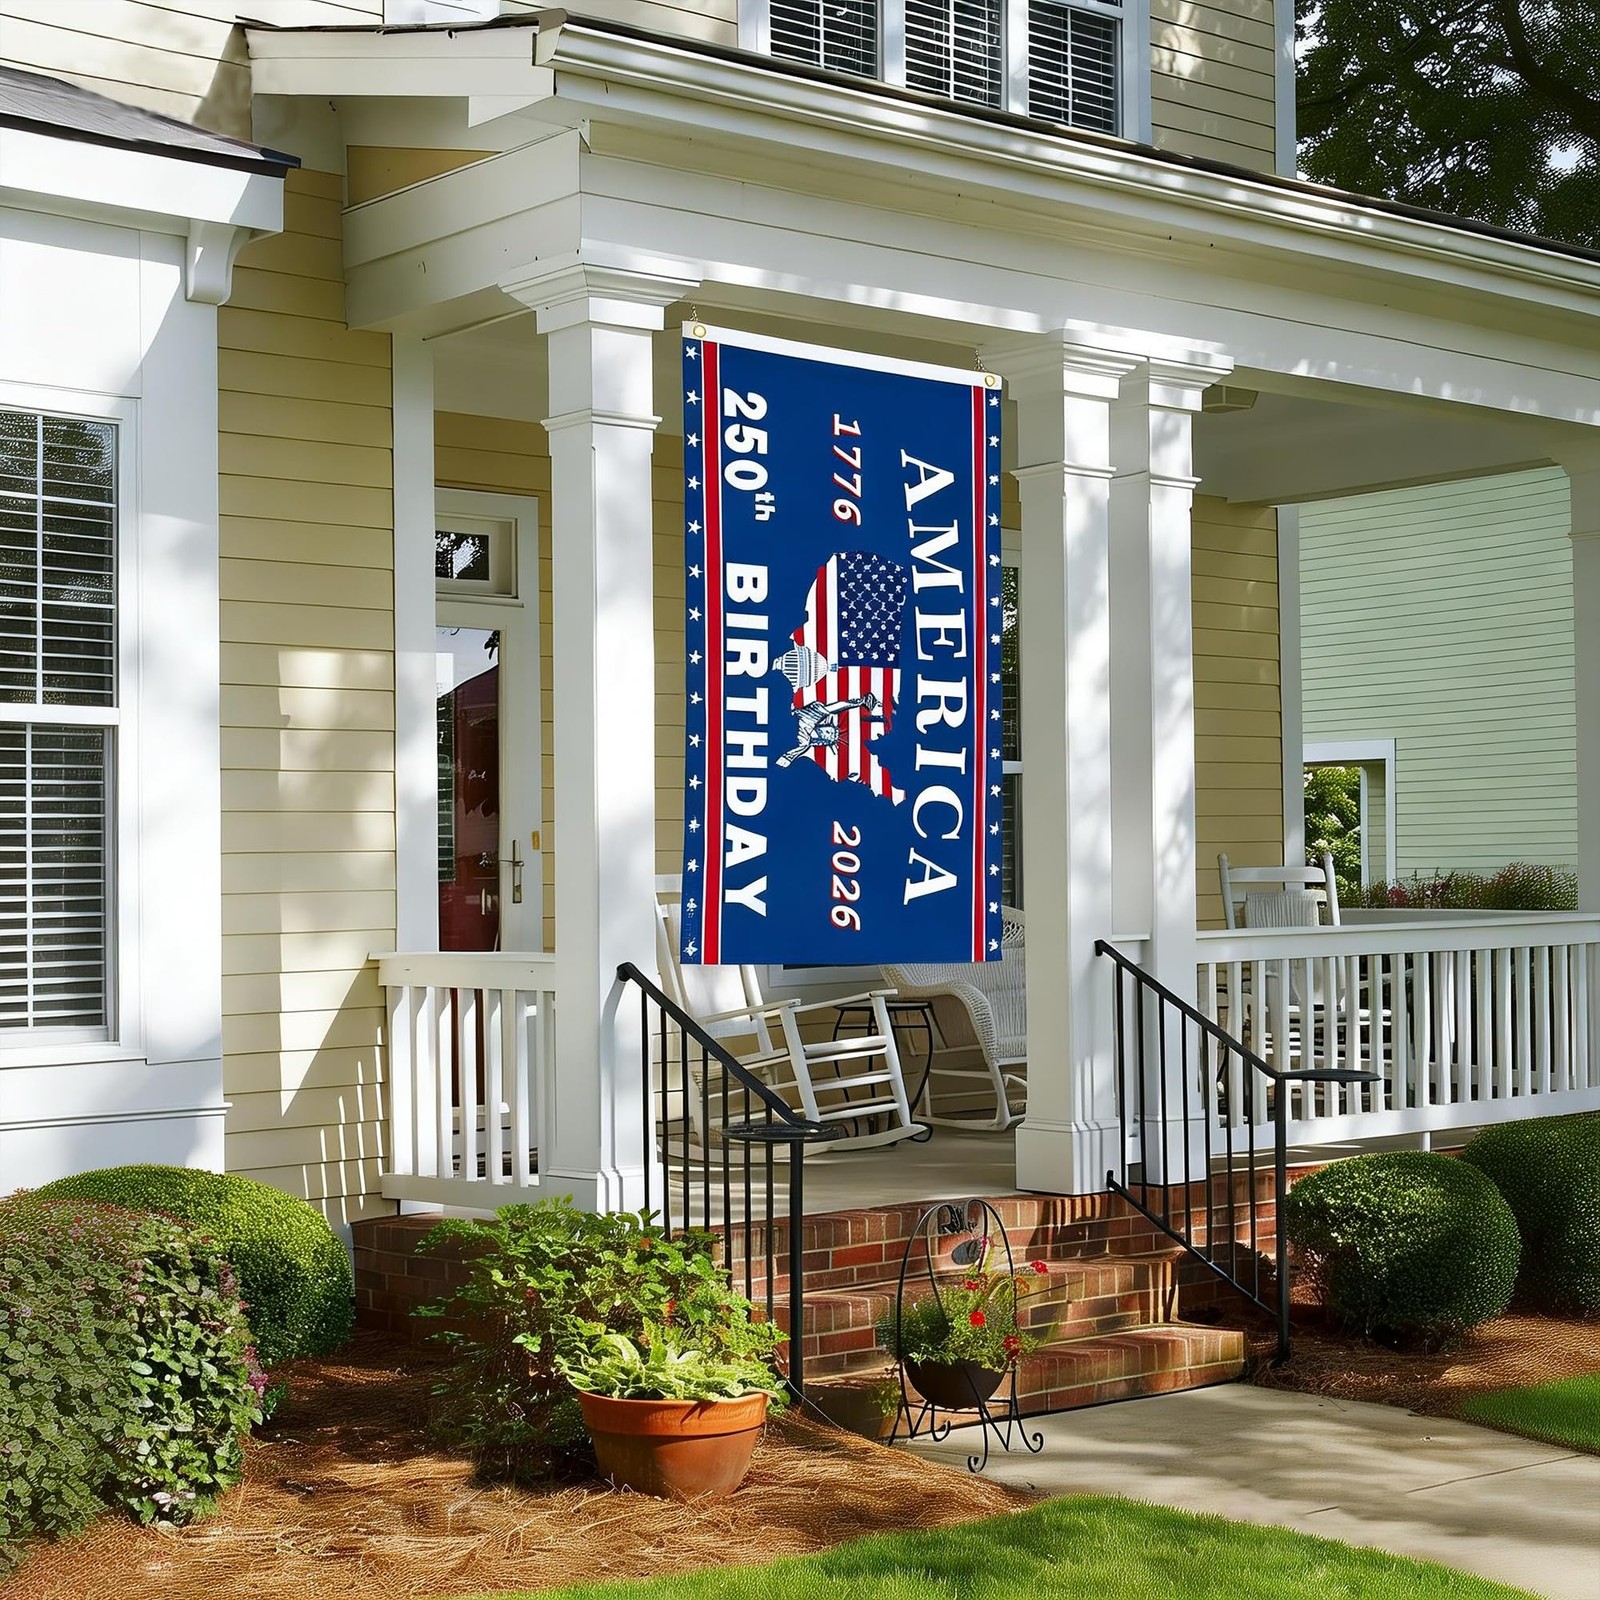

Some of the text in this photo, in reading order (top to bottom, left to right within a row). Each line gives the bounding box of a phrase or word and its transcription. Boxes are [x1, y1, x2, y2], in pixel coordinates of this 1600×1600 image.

[830, 412, 862, 527] 1776
[722, 387, 777, 918] 250th BIRTHDAY
[900, 448, 968, 906] AMERICA
[830, 819, 862, 933] 2026
